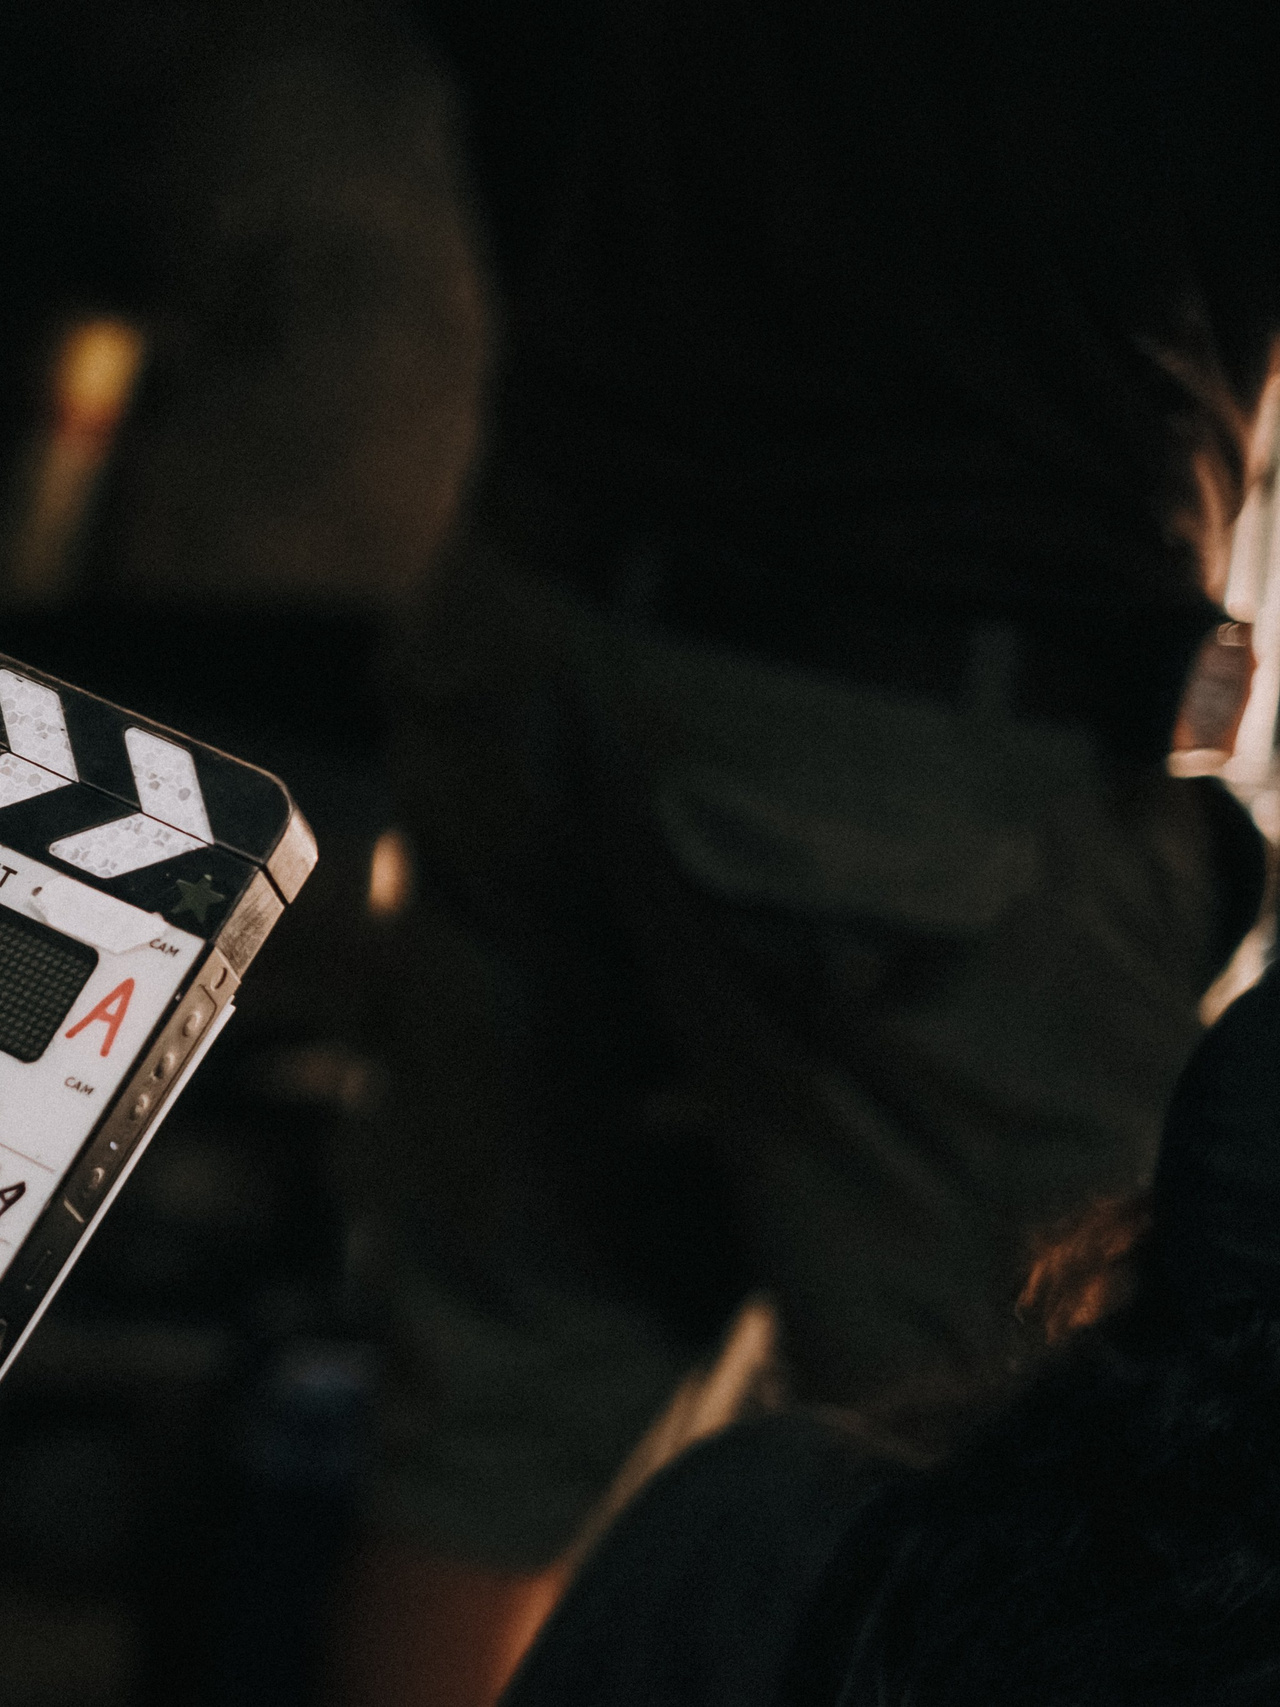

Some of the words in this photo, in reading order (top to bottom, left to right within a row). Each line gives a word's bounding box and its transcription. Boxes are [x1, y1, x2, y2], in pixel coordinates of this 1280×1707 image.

[149, 938, 179, 957] CAM
[65, 977, 135, 1057] A
[64, 1076, 95, 1096] CAM
